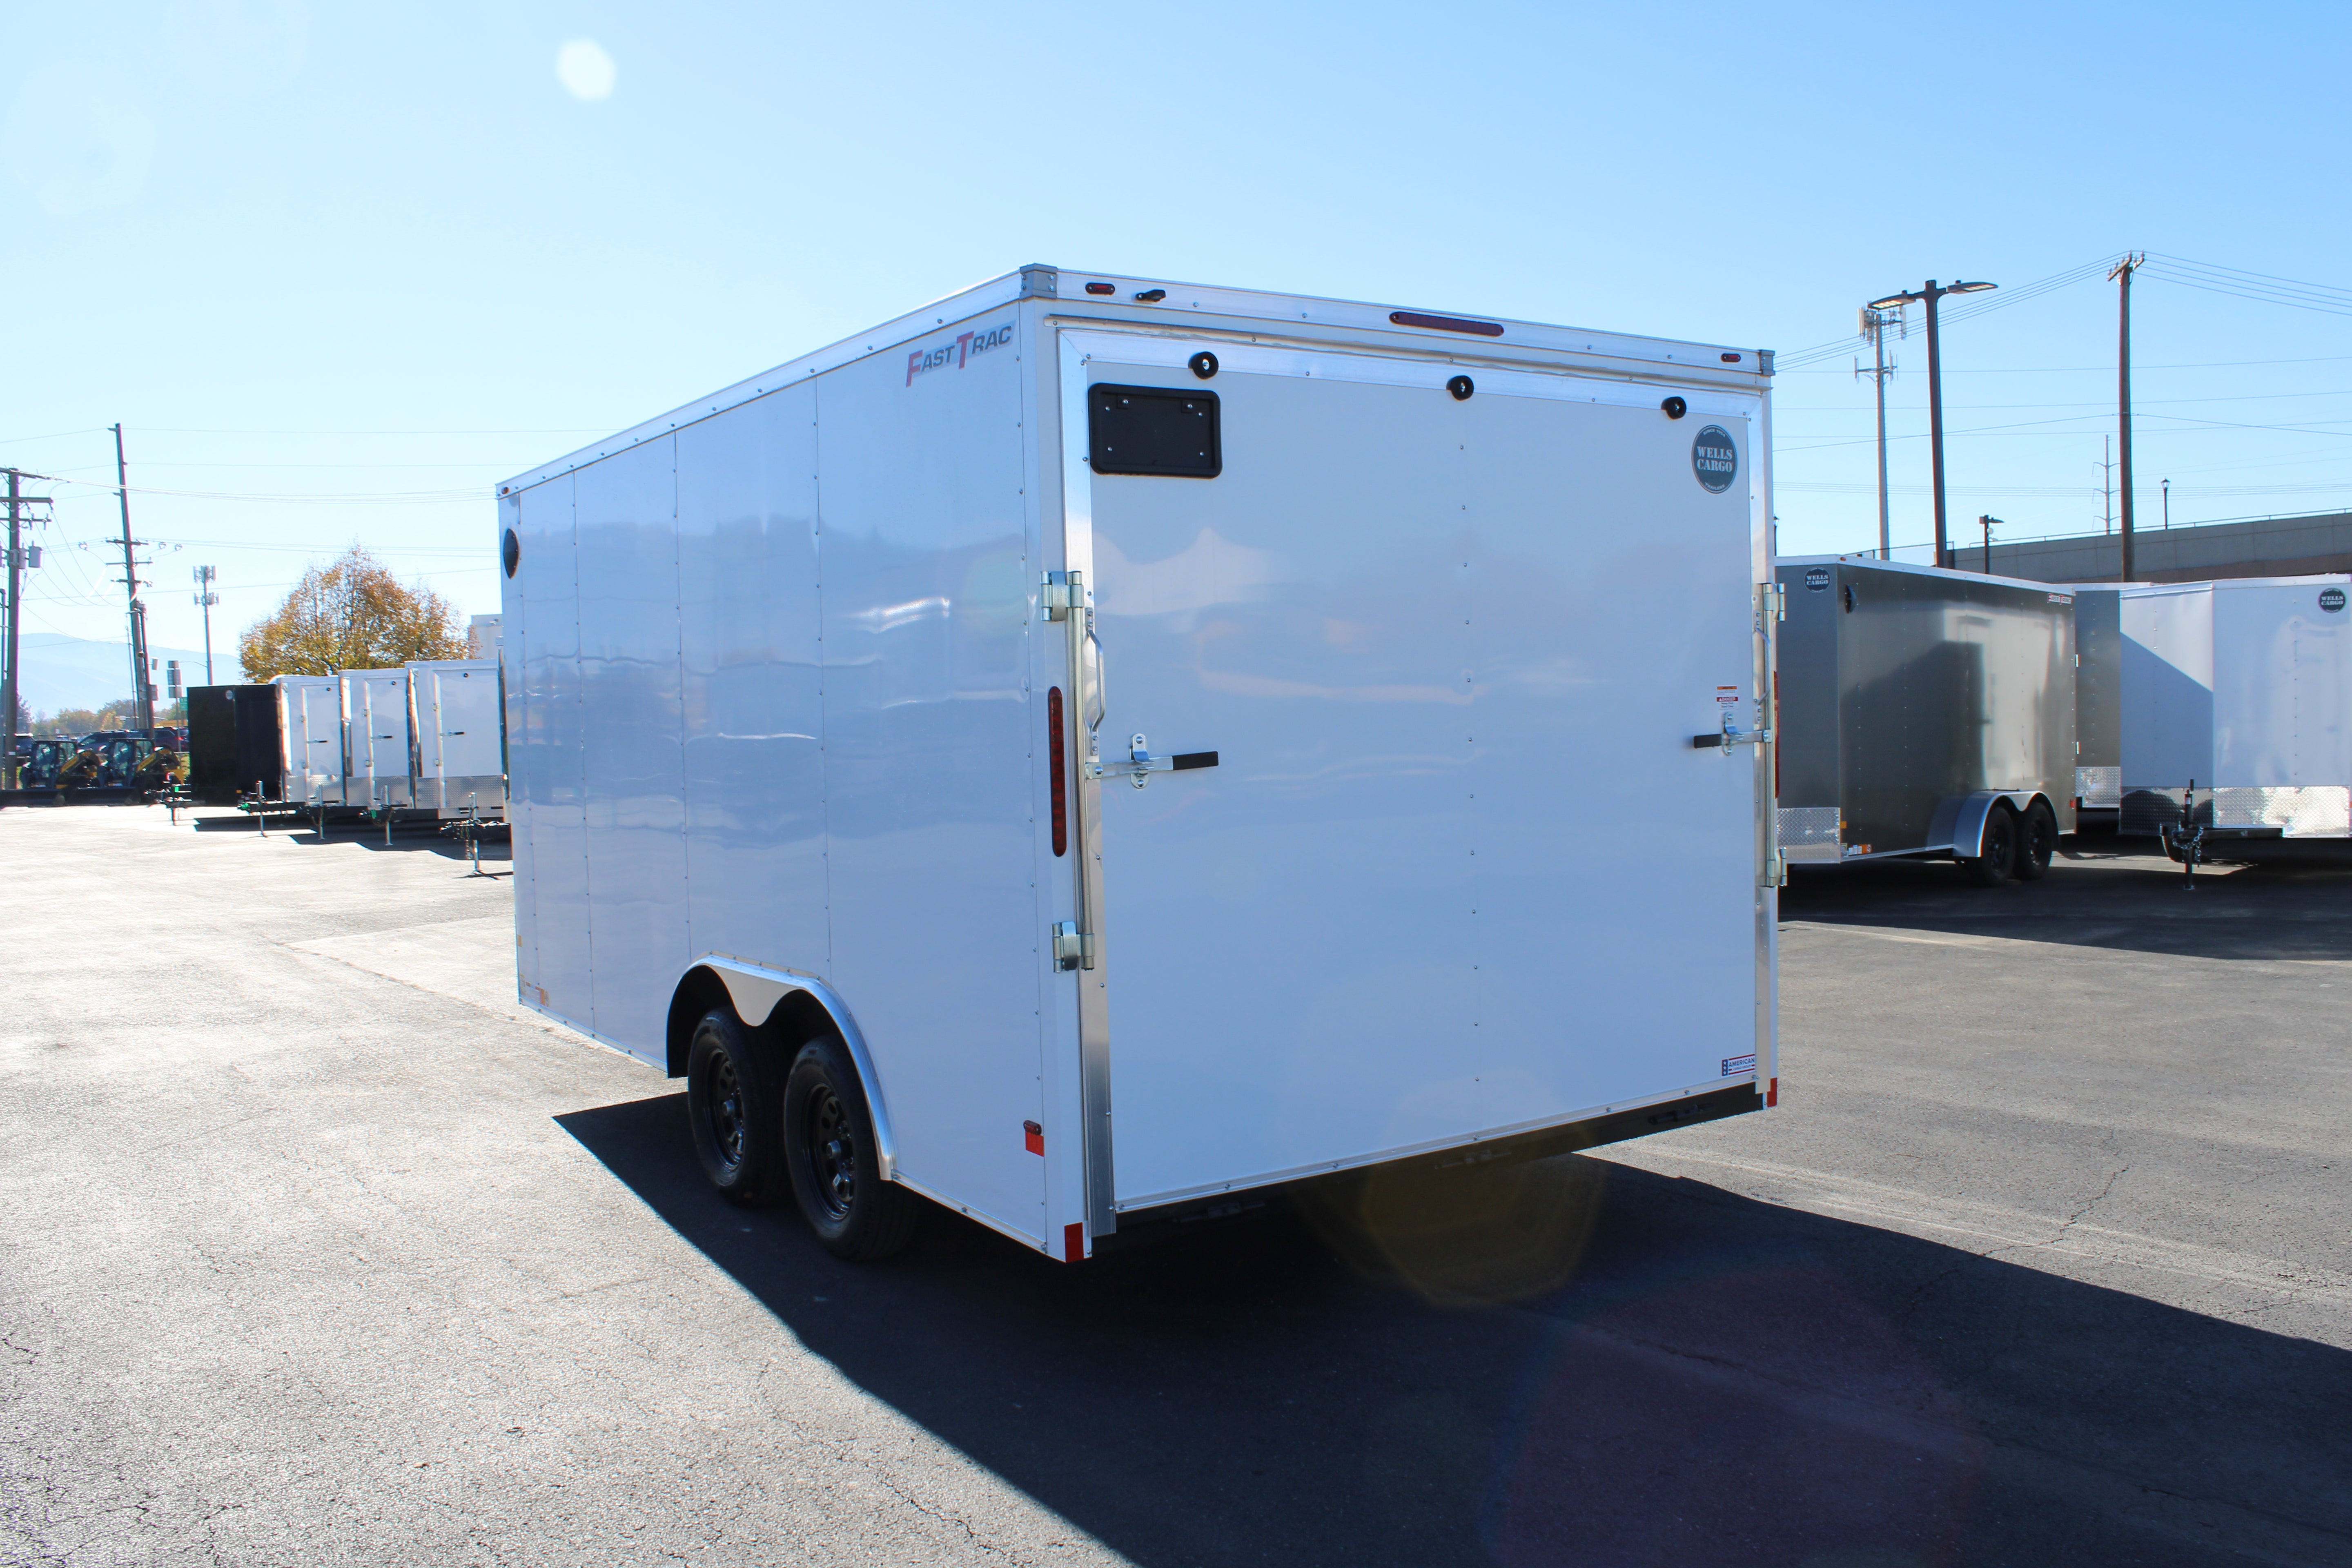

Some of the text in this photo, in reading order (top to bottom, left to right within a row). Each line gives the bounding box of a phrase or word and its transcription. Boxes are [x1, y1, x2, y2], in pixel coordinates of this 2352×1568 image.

[906, 325, 1012, 388] FAST TRAC
[1697, 446, 1733, 460] WELLS
[1697, 459, 1733, 472] CARGO
[1705, 482, 1725, 490] TRAILERS
[1728, 1057, 1755, 1067] AMERICAN
